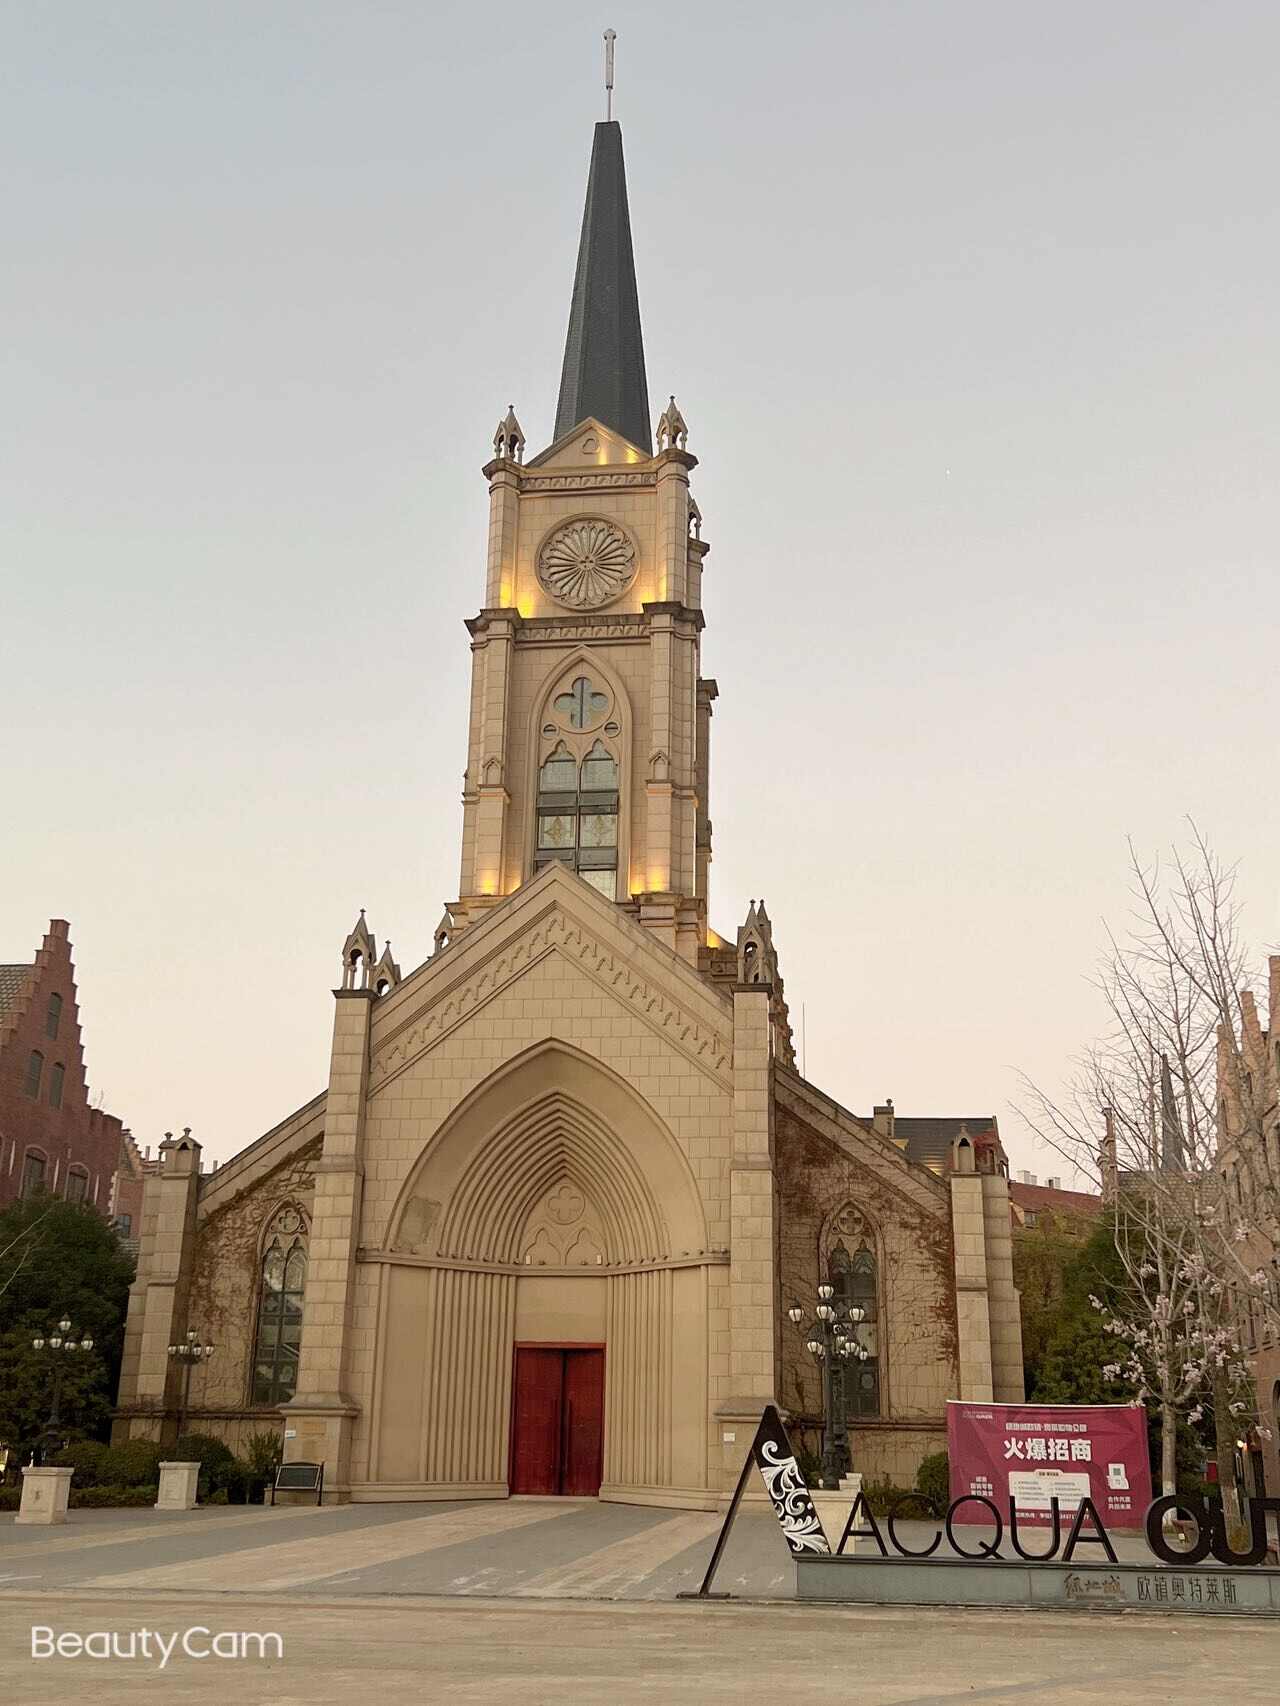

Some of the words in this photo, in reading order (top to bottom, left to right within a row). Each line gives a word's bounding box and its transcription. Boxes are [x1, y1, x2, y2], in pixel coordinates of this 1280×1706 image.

[1004, 1437, 1091, 1461] 火爆招商
[837, 1491, 1119, 1564] ACQUA
[1137, 1576, 1237, 1604] 欧镇奥特莱斯
